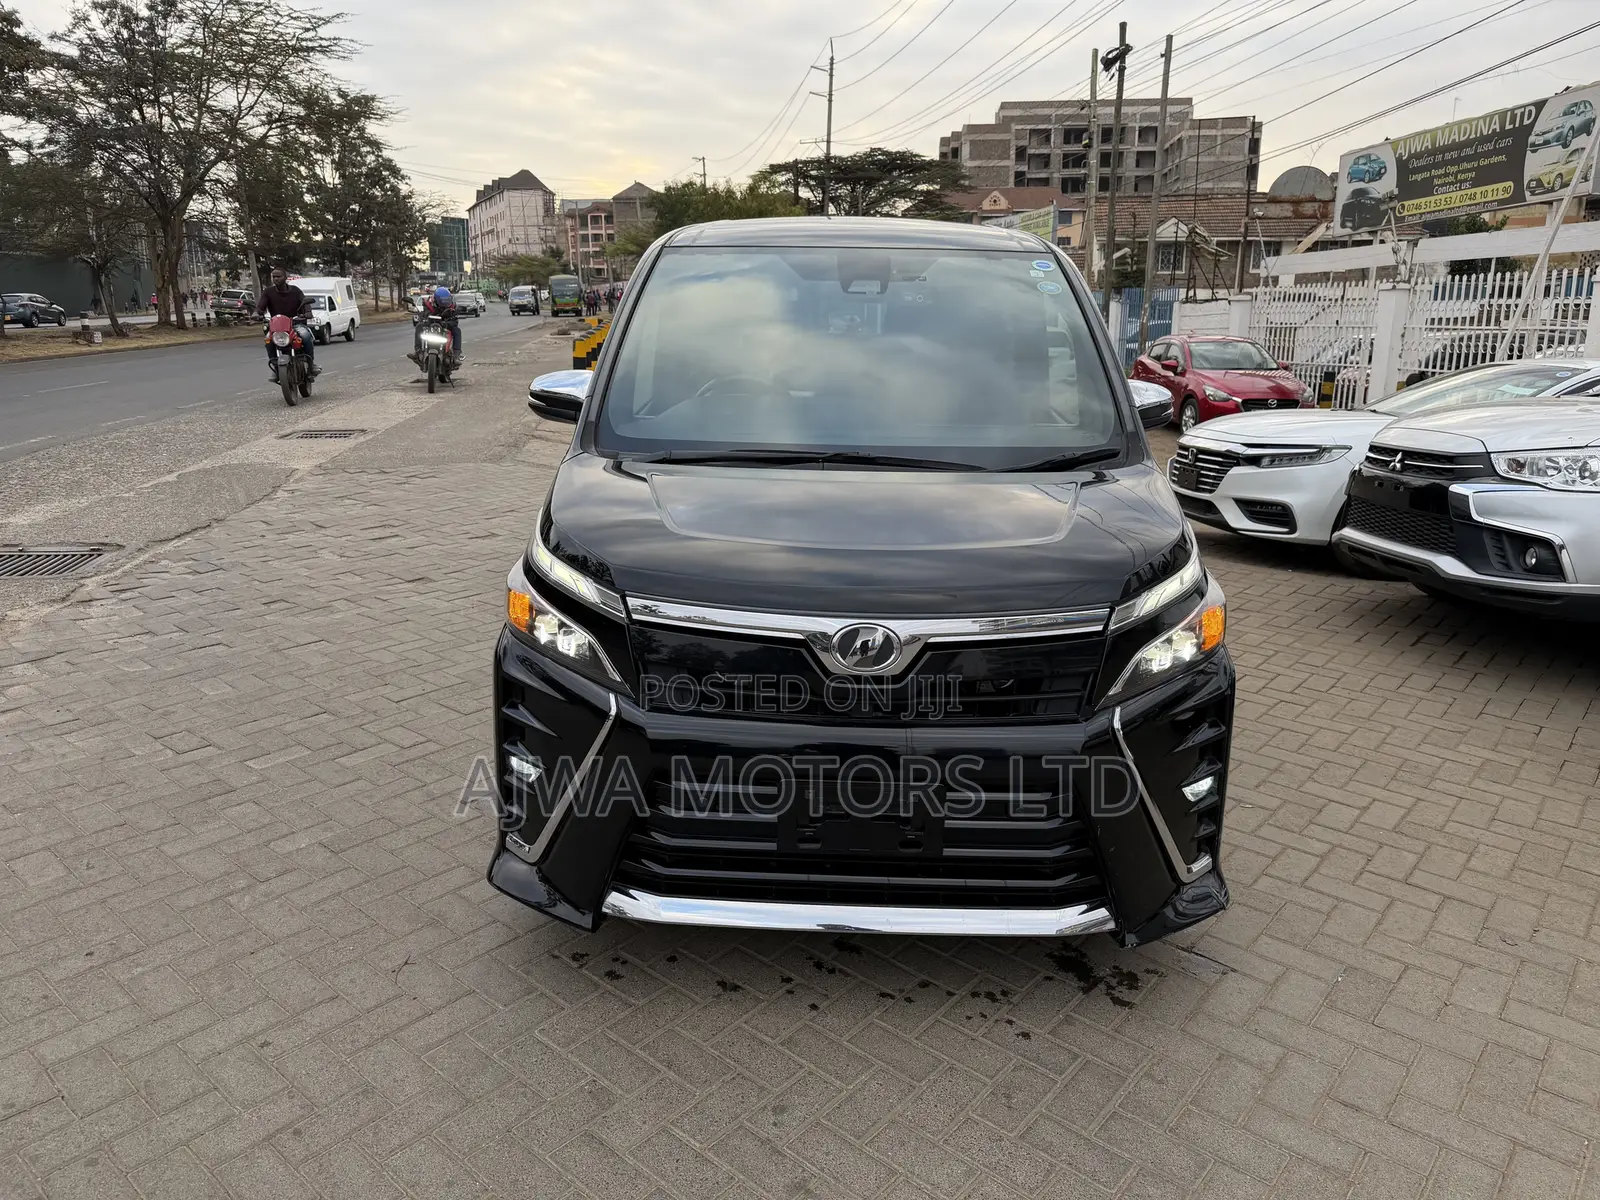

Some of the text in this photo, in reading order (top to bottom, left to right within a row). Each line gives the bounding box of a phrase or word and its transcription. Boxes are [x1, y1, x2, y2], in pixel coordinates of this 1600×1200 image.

[1396, 105, 1536, 160] AJWA MADINA LTD
[1408, 137, 1513, 169] Dealers in new and used cars
[1408, 170, 1430, 182] Langata
[1430, 167, 1446, 177] Road
[1479, 154, 1507, 166] Gardens,
[1457, 171, 1476, 182] Kenya
[1406, 201, 1422, 213] 0746
[1423, 200, 1432, 210] 51
[1433, 198, 1442, 208] 53
[1443, 196, 1453, 206] 53
[1459, 191, 1477, 203] 0748
[1480, 190, 1488, 199] 10
[1490, 188, 1499, 197] 11
[1501, 185, 1512, 195] 90
[1433, 181, 1472, 195] Contact us:
